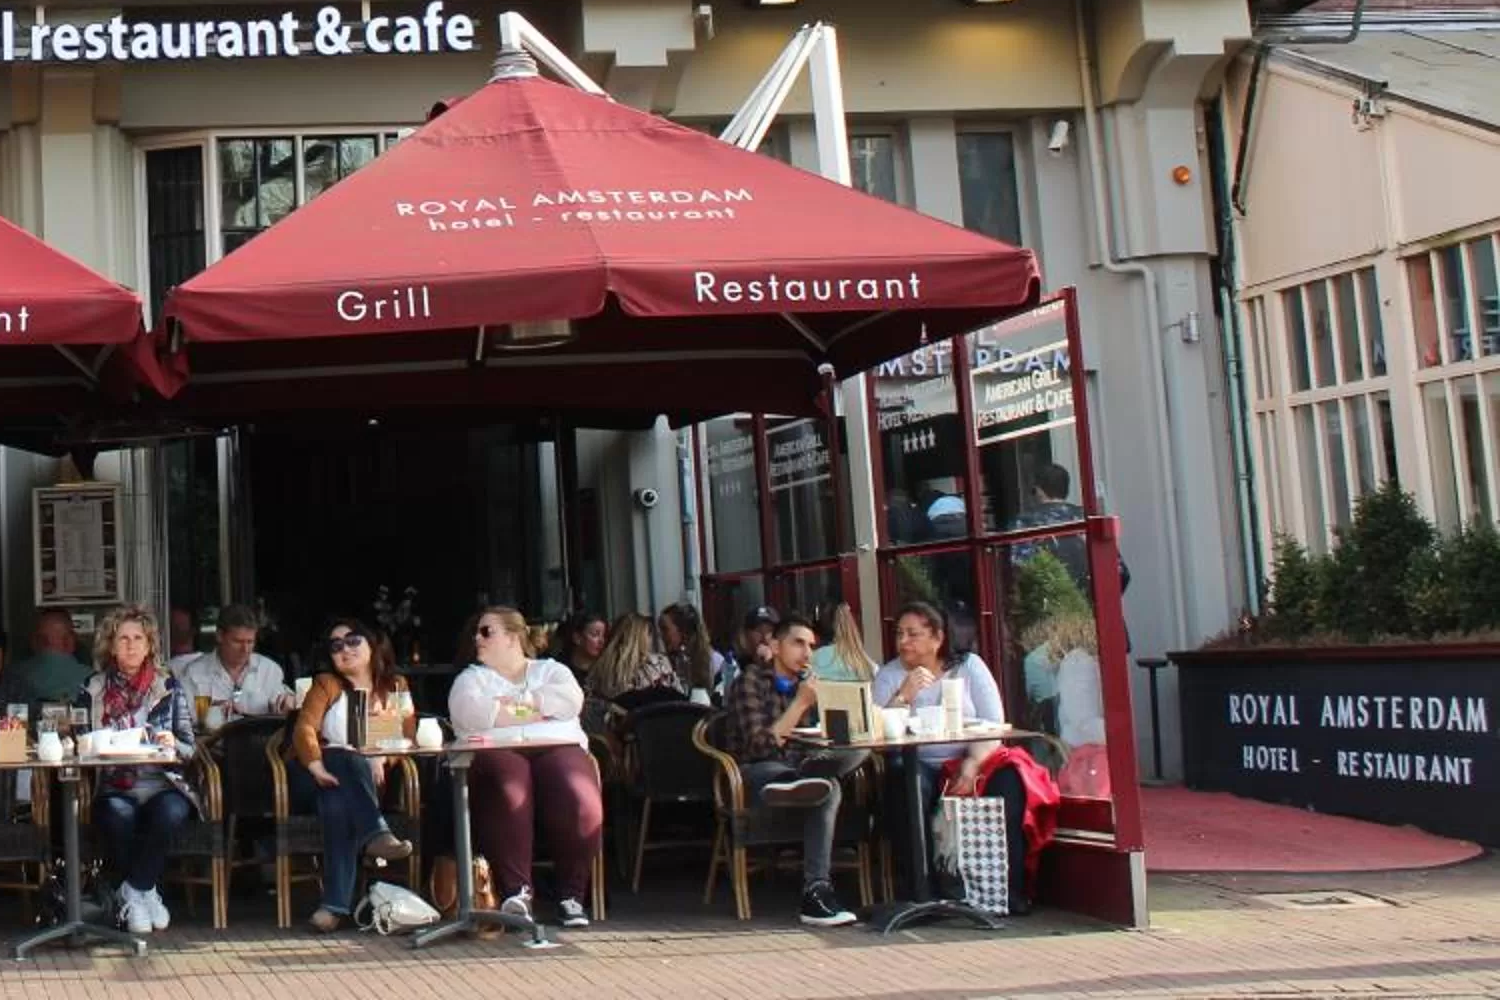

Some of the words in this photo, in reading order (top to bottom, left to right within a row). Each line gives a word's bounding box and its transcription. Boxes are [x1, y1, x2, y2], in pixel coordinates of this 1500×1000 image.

[30, 11, 299, 61] restaurant
[314, 5, 352, 55] &
[365, 0, 475, 53] cafe
[396, 197, 517, 216] ROYAL
[532, 188, 754, 207] AMSTERDAM
[428, 213, 514, 231] hotel
[562, 206, 736, 222] restaurant
[337, 287, 431, 322] Grill
[696, 271, 921, 303] Restaurant
[1228, 693, 1300, 726] ROYAL
[1320, 695, 1488, 733] AMSTERDAM
[1243, 745, 1300, 773] HOTEL
[1337, 751, 1472, 785] RESTAURANT
